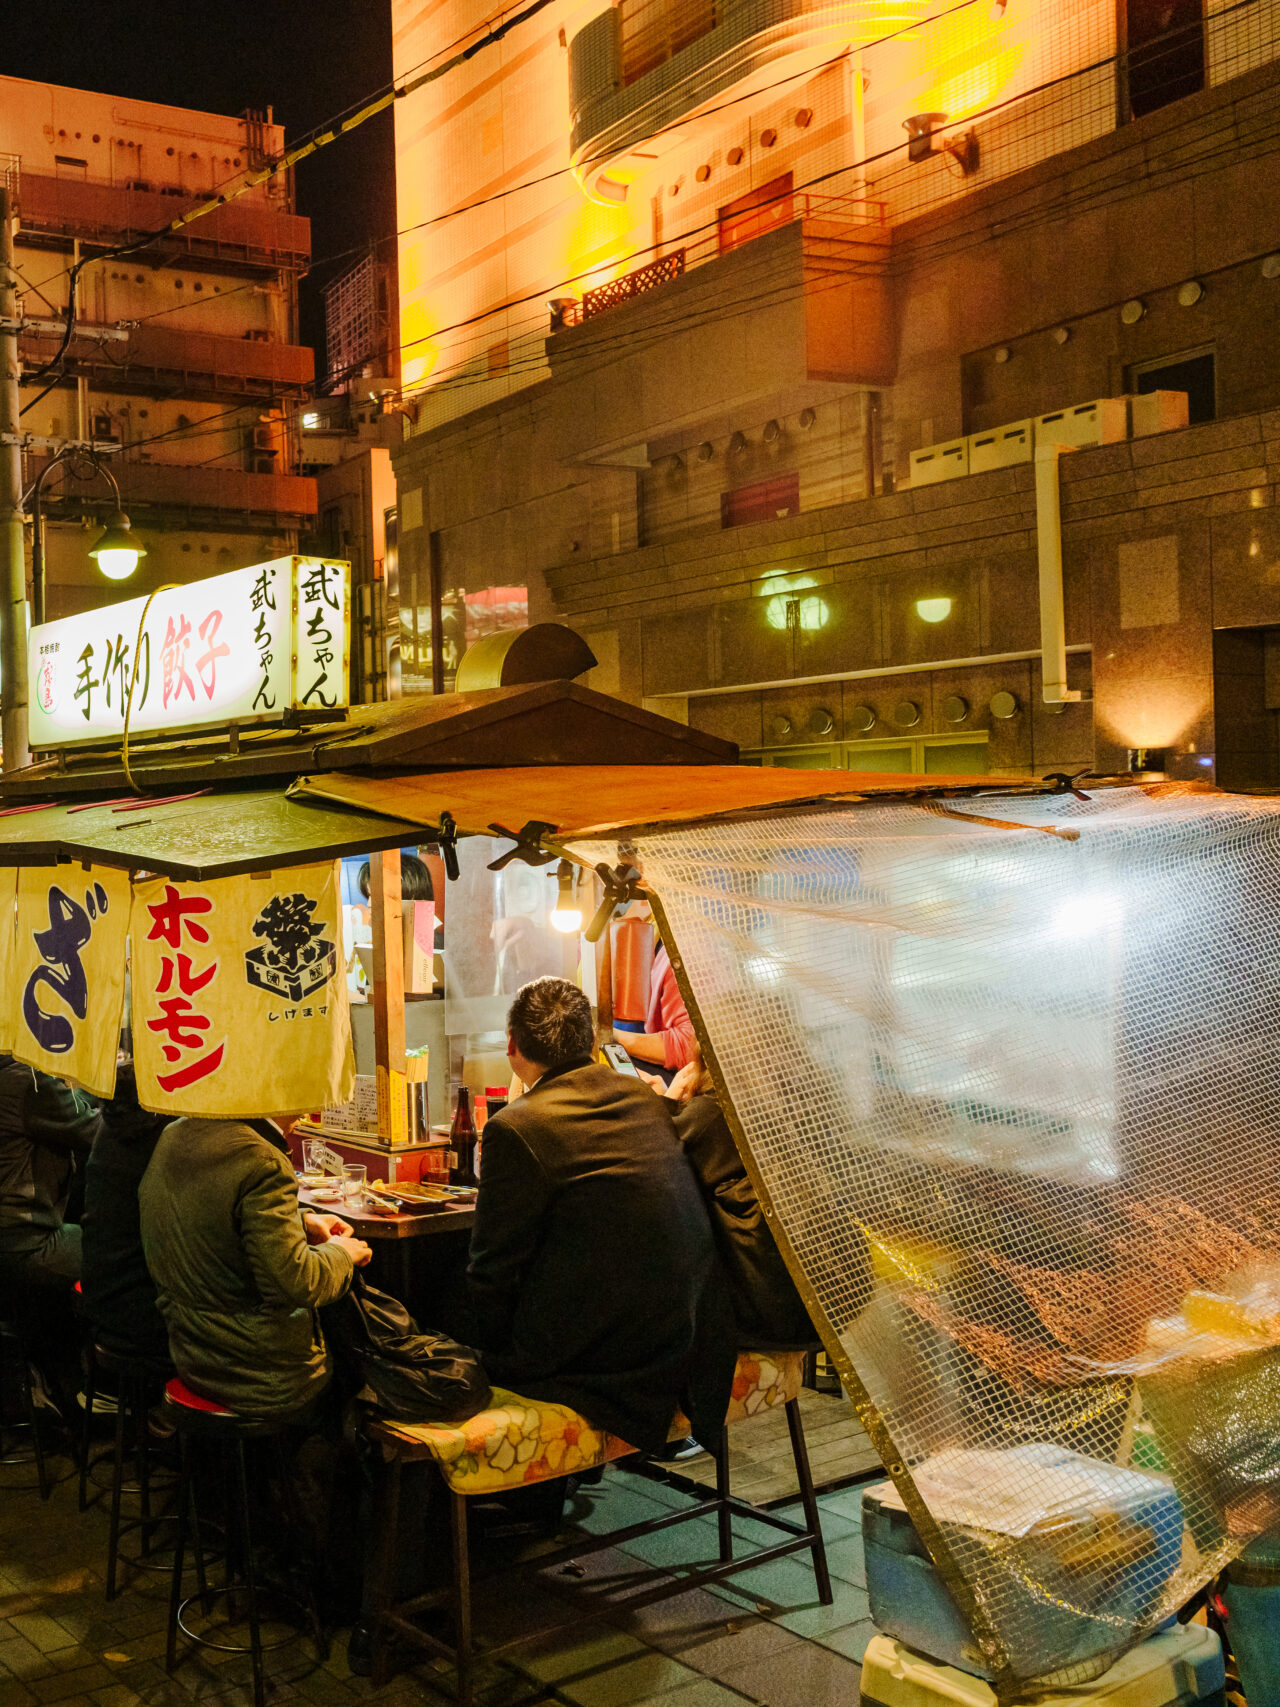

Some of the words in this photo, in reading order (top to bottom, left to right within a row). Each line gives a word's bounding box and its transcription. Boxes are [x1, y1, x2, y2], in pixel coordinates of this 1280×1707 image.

[249, 569, 276, 711] 武ちゃん
[301, 564, 340, 709] 武ちゃん
[147, 885, 225, 1093] ホルモン
[269, 1006, 328, 1021] しげます
